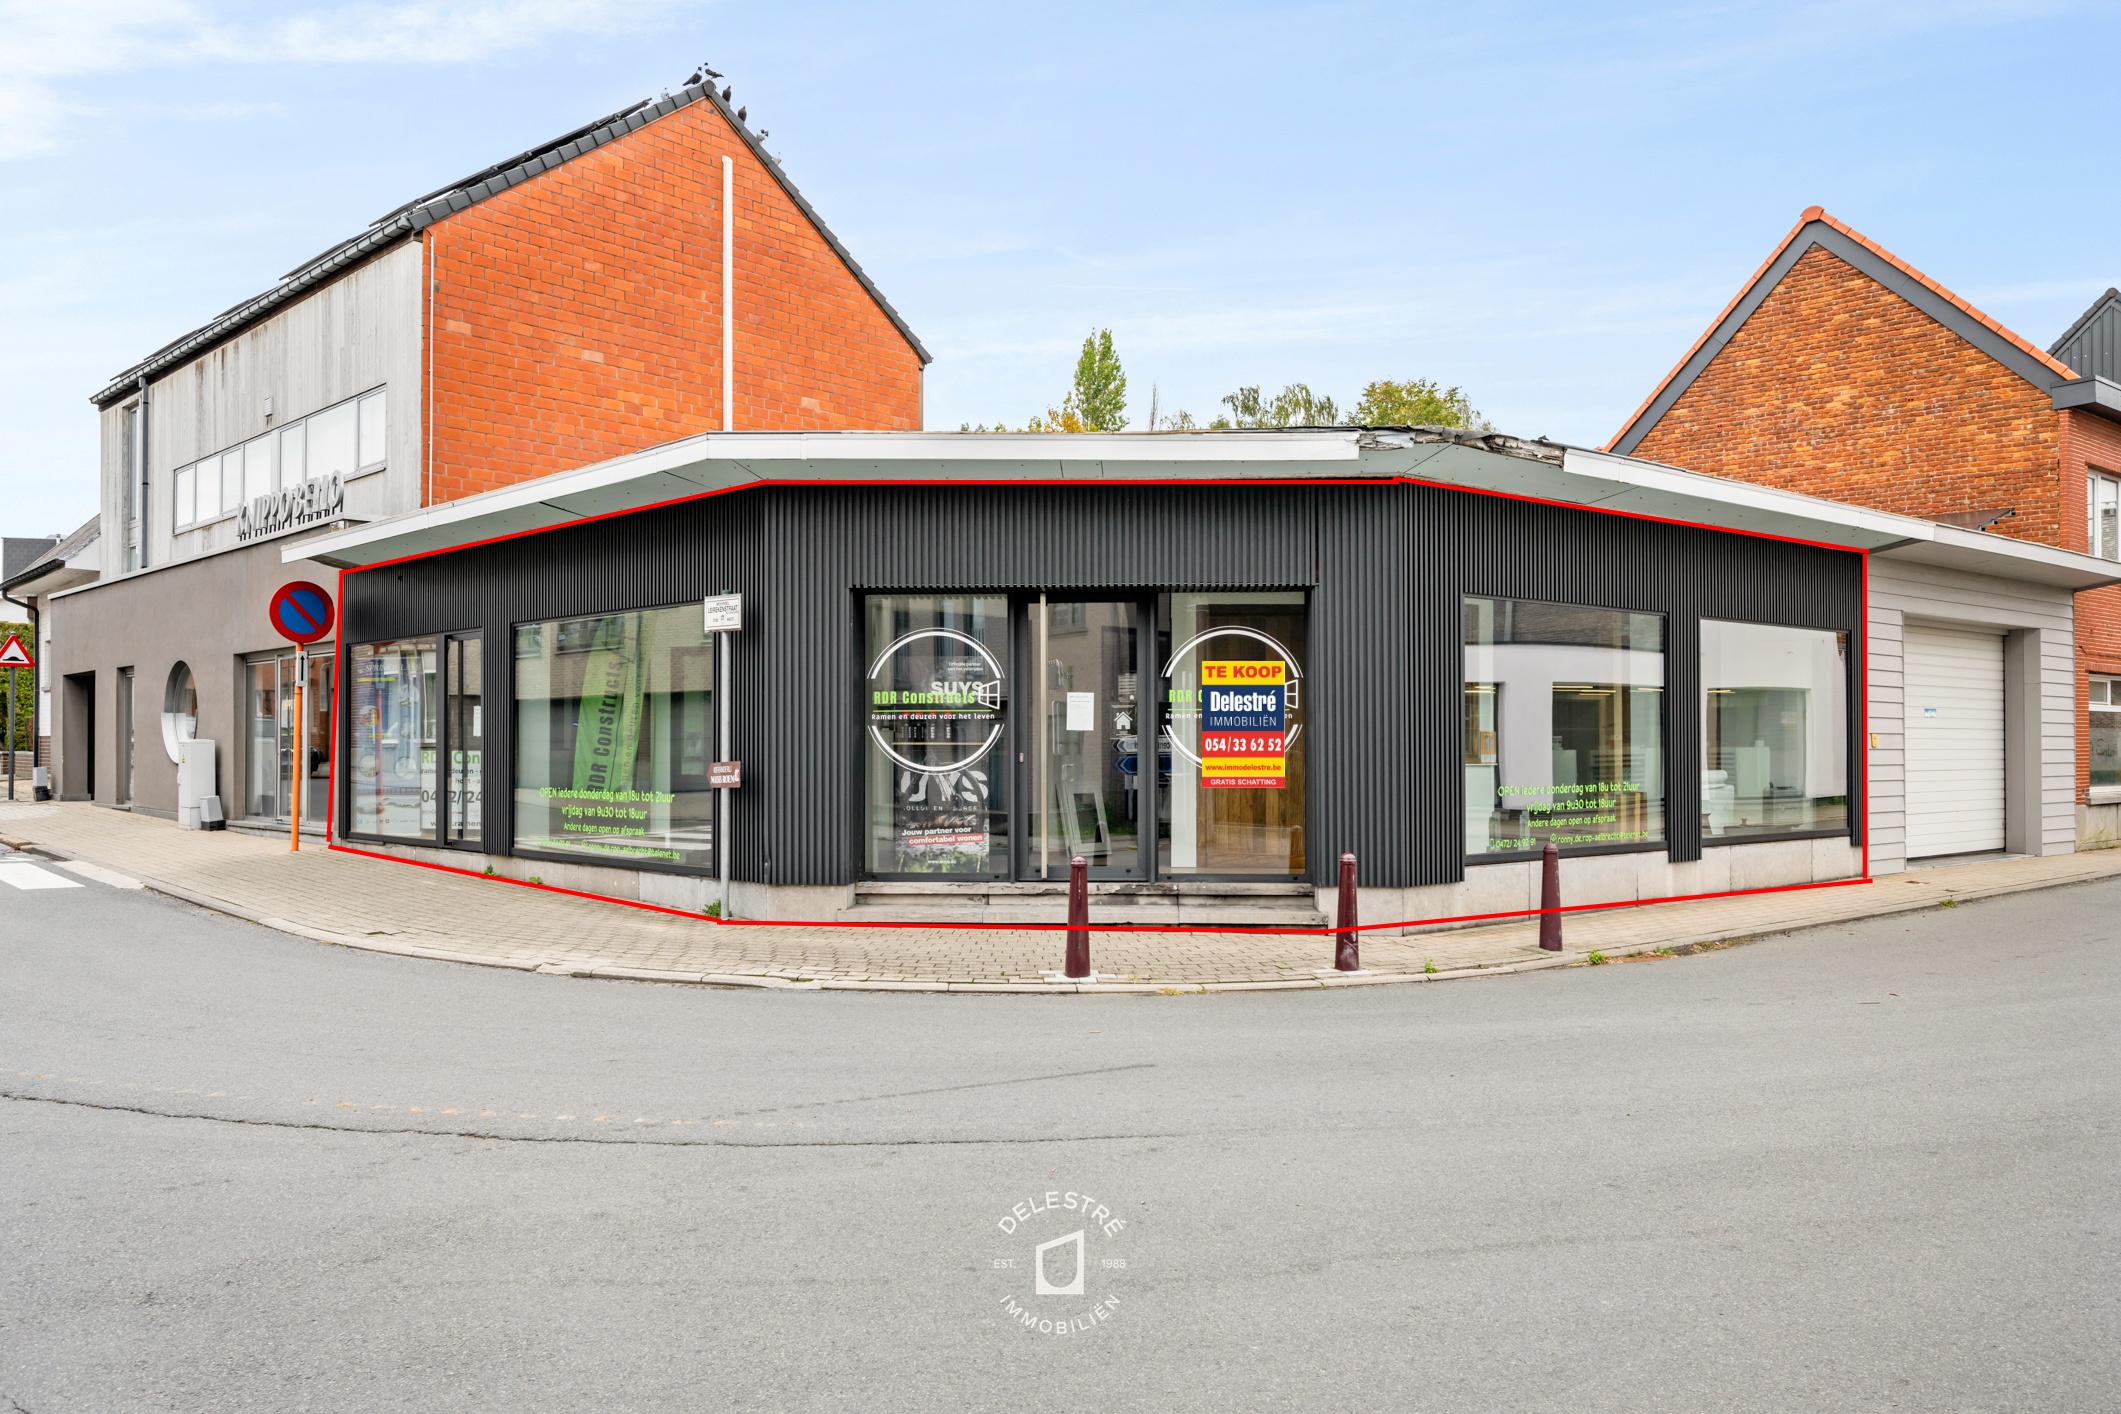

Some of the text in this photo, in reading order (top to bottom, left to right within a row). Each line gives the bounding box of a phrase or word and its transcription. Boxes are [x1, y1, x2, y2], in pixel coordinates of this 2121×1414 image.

[1205, 665, 1282, 678] TE KOOP
[931, 681, 984, 696] SUYS
[873, 690, 976, 704] RDR Constructs
[1169, 690, 1193, 703] RDR
[1210, 690, 1276, 712] Delestré
[1210, 714, 1277, 727] IMMOBILIËN
[1205, 736, 1282, 752] 054/33 62 52
[1205, 763, 1282, 771] www.immodelestre.be
[540, 787, 557, 798] OPEN
[558, 787, 578, 799] iedere
[579, 788, 613, 803] donderdag
[615, 791, 628, 801] van
[629, 789, 640, 801] 18u
[641, 790, 653, 802] tot
[1497, 781, 1641, 797] OPEN iedere donderdag van 18u tot 21uur
[561, 804, 647, 819] vrijdag van 9u30 tot 18uur
[1526, 799, 1616, 815] vrijdag van 9u30 tot 18uur
[1528, 814, 1617, 829] Andere dagen open op afspraak
[563, 822, 645, 837] Andere dagen open op afspraak
[924, 827, 953, 836] partner
[909, 836, 956, 845] comfortabel
[1513, 839, 1521, 848] 24
